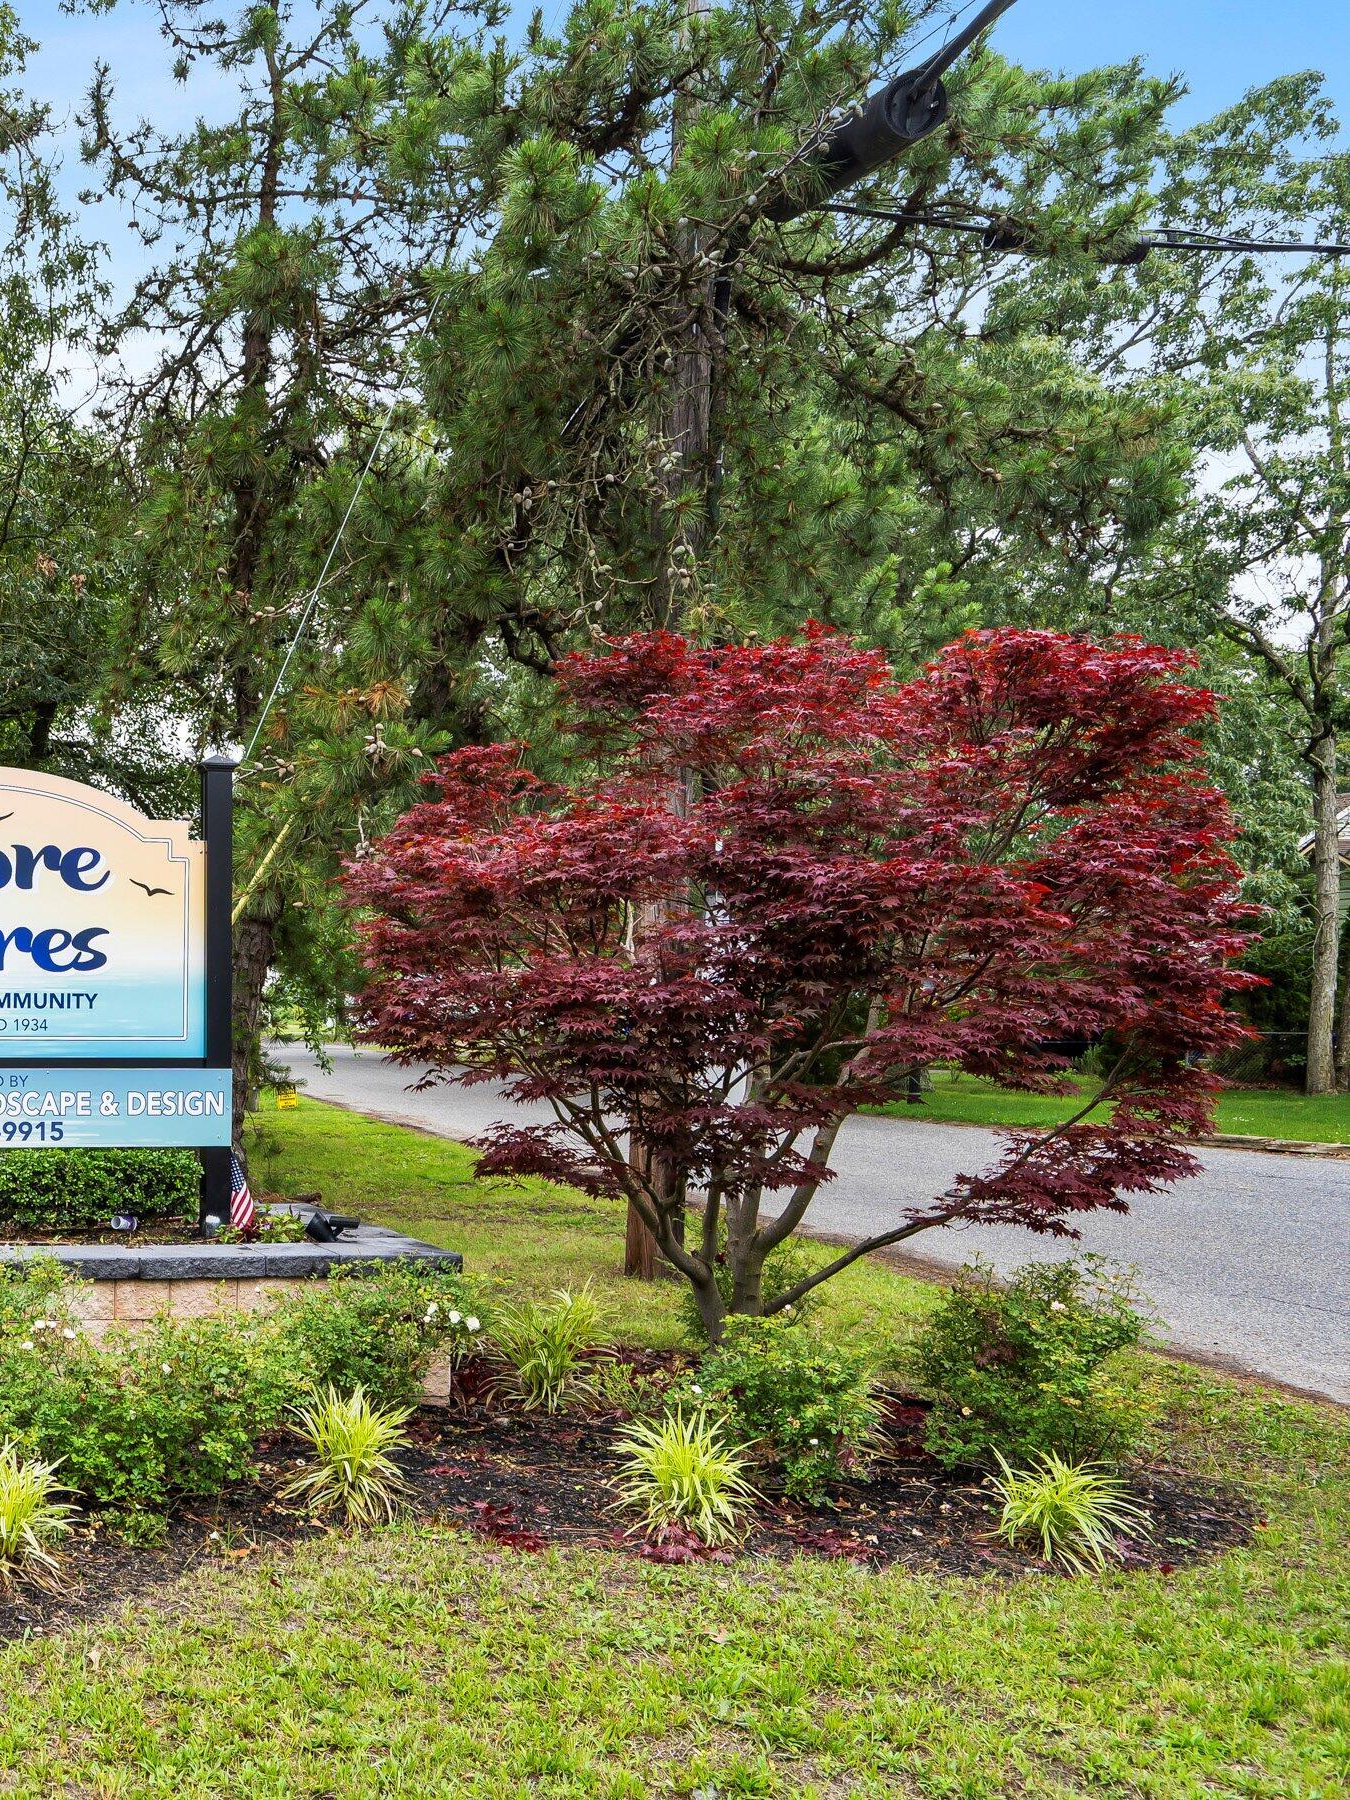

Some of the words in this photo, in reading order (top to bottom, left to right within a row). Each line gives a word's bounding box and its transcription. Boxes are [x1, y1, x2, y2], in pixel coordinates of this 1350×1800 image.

[13, 1018, 49, 1032] 1934
[9, 1075, 29, 1088] BY
[99, 1090, 120, 1117] &
[126, 1090, 224, 1117] DESIGN
